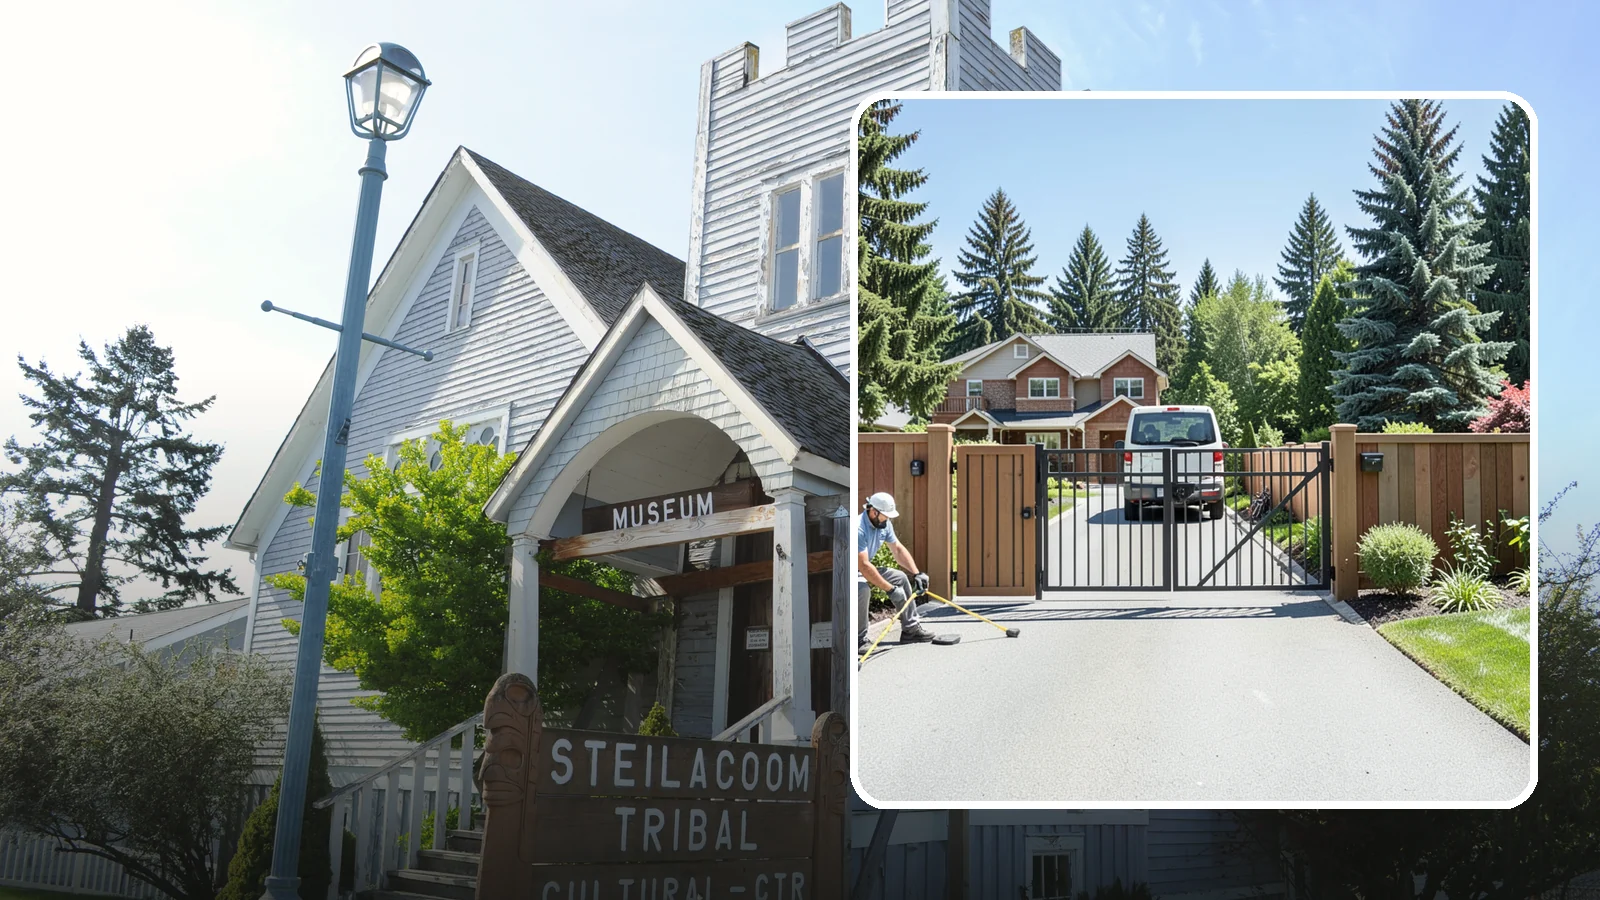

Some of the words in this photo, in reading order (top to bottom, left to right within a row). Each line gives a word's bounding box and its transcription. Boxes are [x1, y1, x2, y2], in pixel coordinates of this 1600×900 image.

[613, 492, 713, 530] MUSEUM
[551, 738, 809, 792] STEILACOOM
[615, 807, 758, 852] TRIBAL
